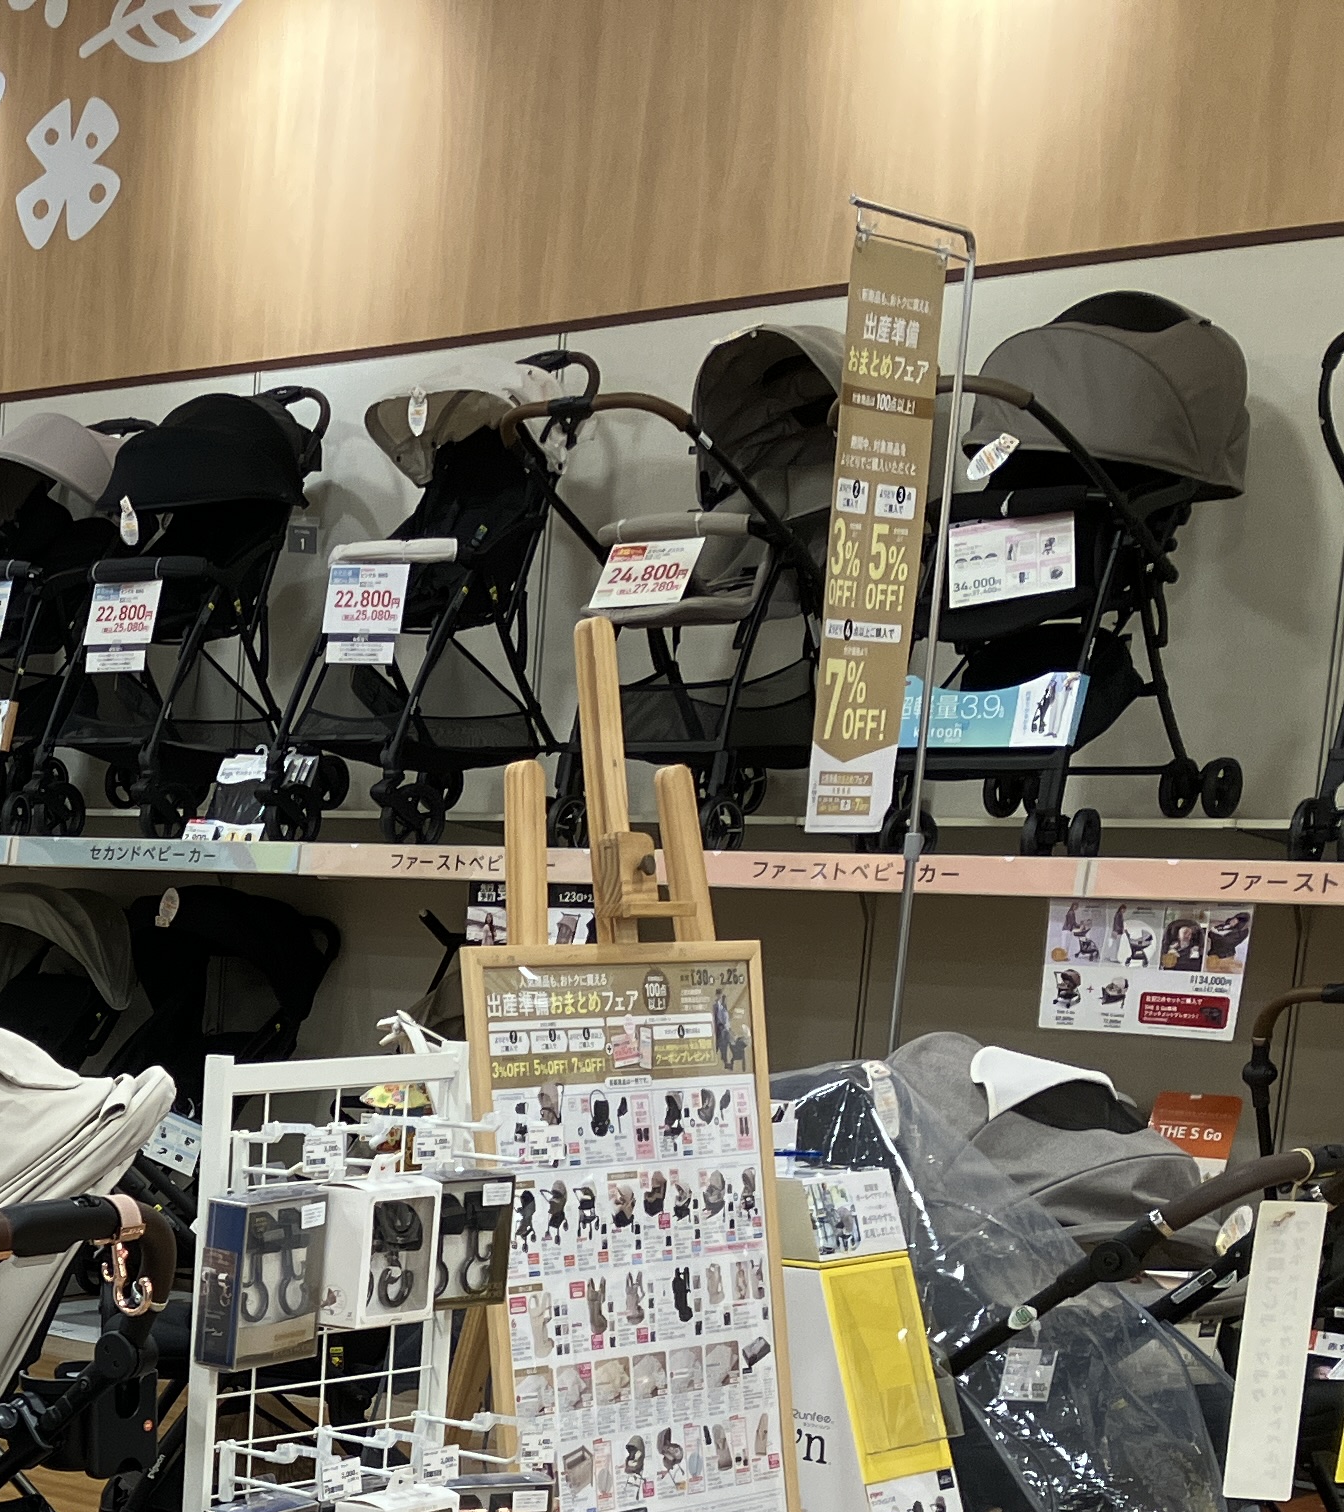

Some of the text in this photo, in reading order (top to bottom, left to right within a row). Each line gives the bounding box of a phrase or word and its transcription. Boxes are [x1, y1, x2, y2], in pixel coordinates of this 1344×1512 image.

[863, 312, 921, 350] 出産準備
[847, 345, 930, 384] おまとめフェア
[830, 517, 861, 579] 3%
[868, 523, 909, 583] 5%
[606, 562, 688, 586] 24,800円
[334, 588, 401, 609] 22,800円
[828, 578, 857, 608] OFF!
[865, 583, 904, 612] OFF!
[95, 604, 154, 623] 22,800円
[823, 657, 867, 740] 7%
[842, 708, 887, 741] OFF!
[89, 844, 218, 864] セカンドベビーカー
[486, 989, 640, 1018] 出産準備おまとめフェア
[1160, 1124, 1223, 1142] THE S Go
